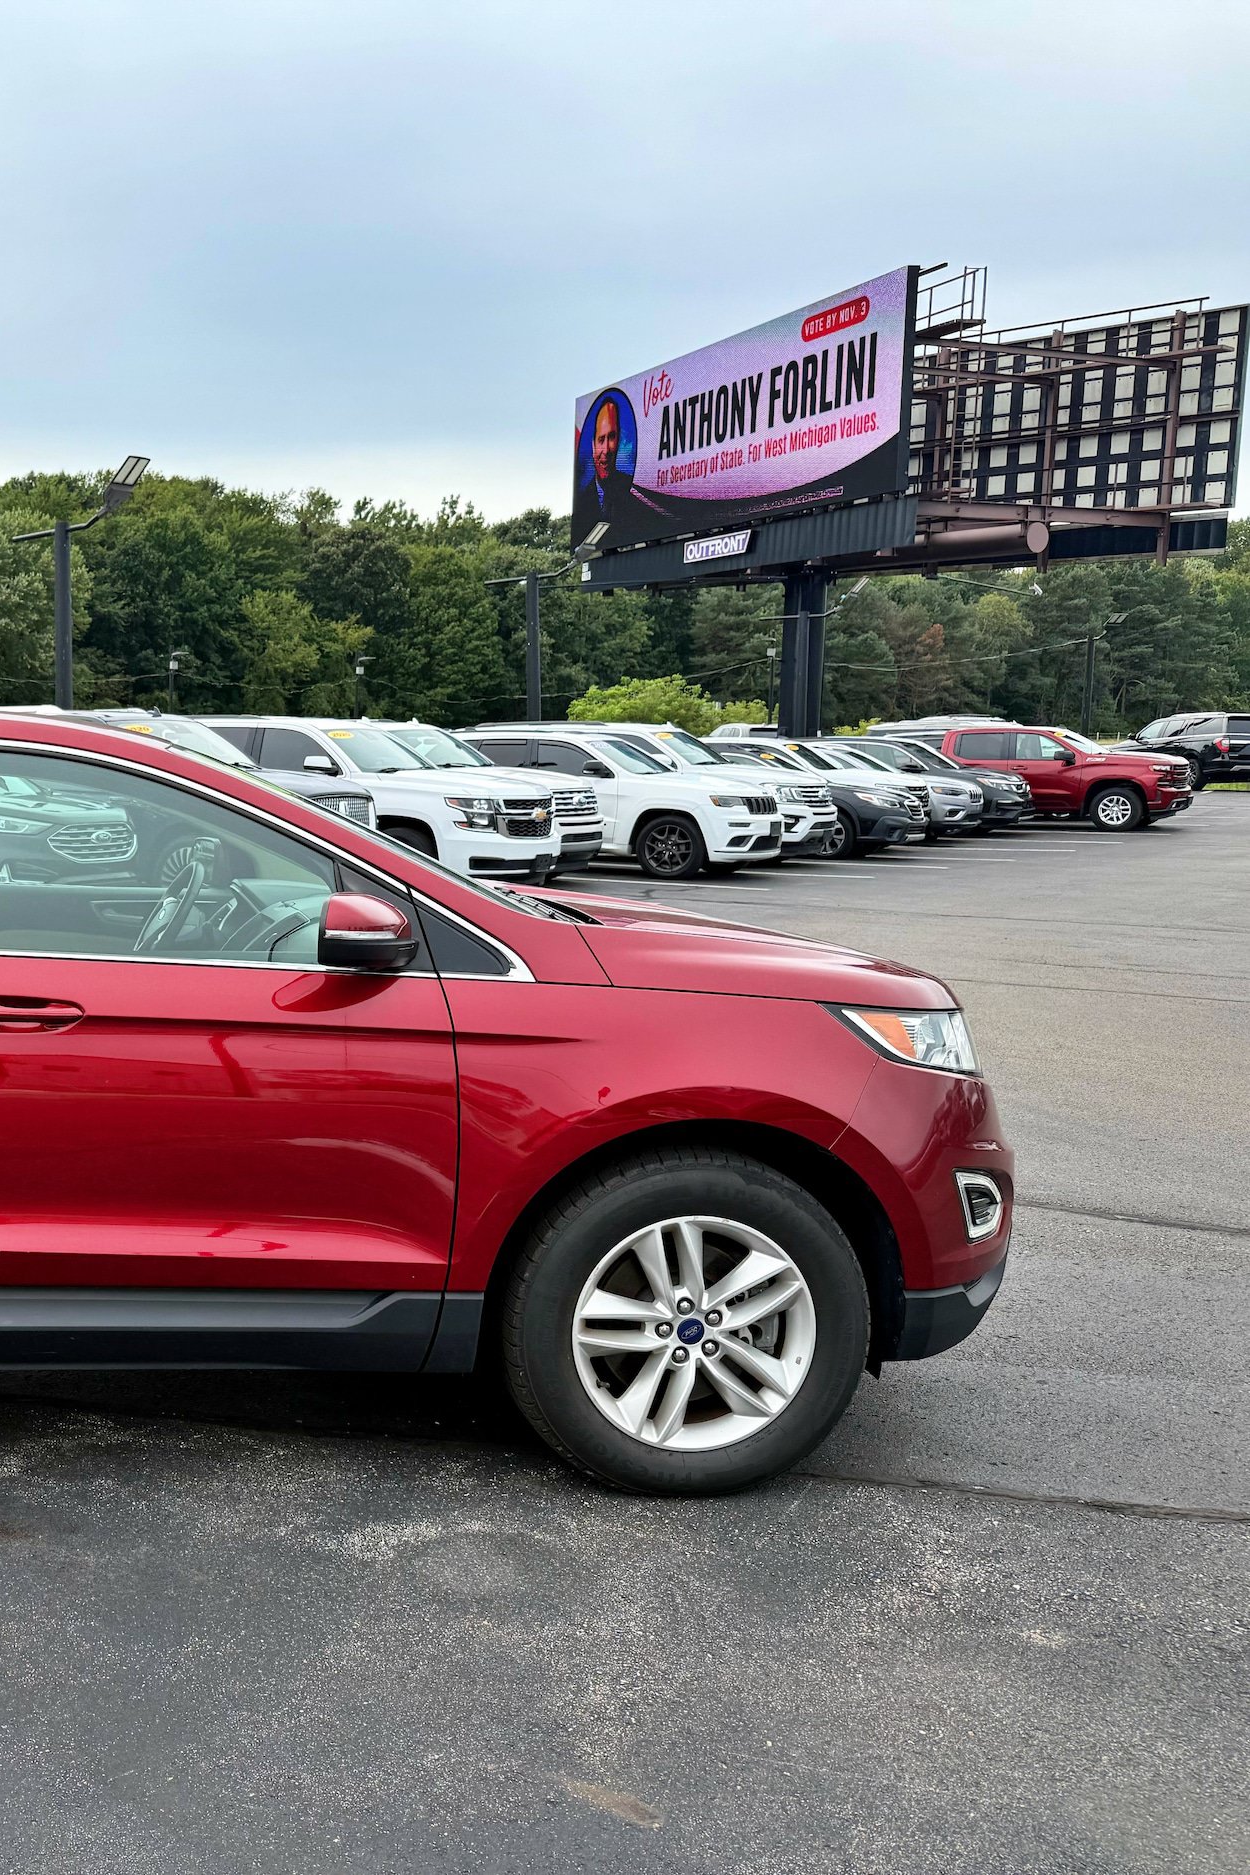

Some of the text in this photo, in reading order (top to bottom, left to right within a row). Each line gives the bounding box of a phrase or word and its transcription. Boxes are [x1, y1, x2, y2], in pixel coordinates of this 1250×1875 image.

[804, 301, 867, 336] VOTE BY NOV. 3
[643, 370, 675, 417] Vote
[658, 331, 878, 461] ANTHONY FORLINI
[656, 411, 880, 488] For Secretary of State. For West Michigan Values.
[686, 535, 747, 560] OUTFRONT
